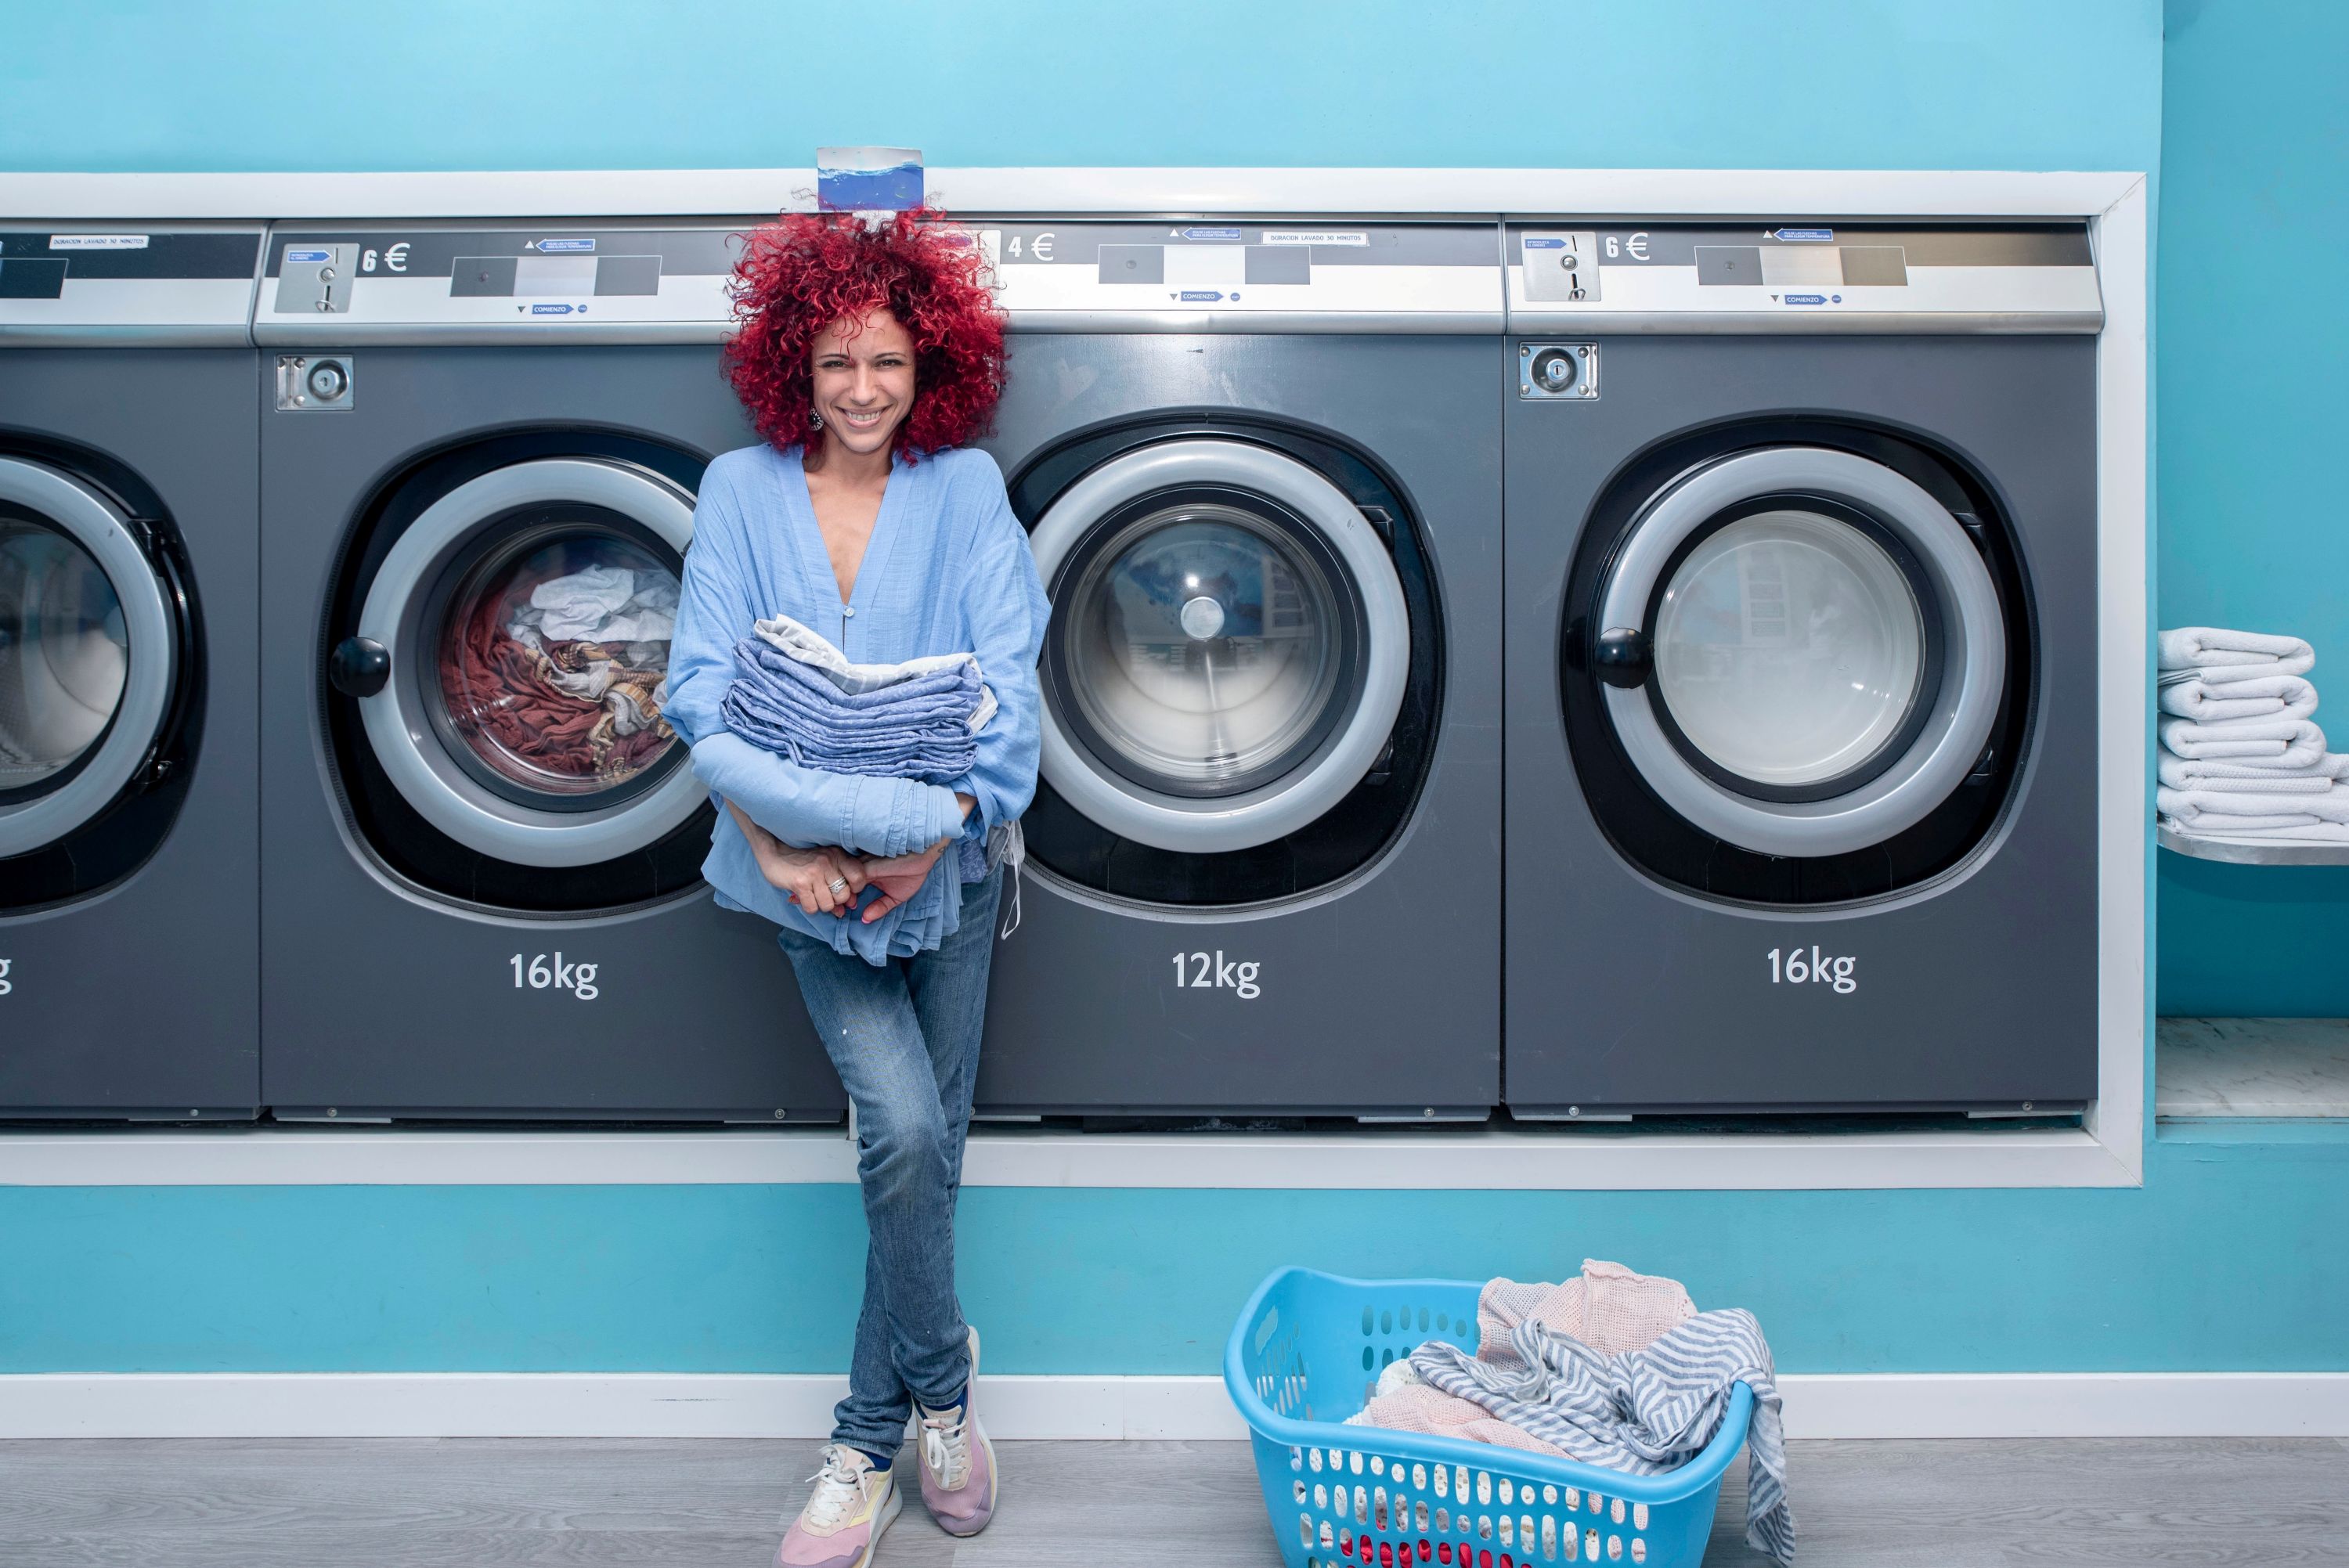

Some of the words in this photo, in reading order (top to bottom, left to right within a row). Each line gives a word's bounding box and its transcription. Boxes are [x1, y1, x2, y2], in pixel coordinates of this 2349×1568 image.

[363, 249, 378, 272] 6
[384, 243, 410, 272] €
[1008, 236, 1023, 258] 4
[1030, 232, 1055, 261] €
[1605, 236, 1619, 258] 6
[1625, 232, 1651, 261] €
[510, 951, 599, 1000] 16kg
[1172, 950, 1261, 999] 12kg
[1767, 945, 1856, 993] 16kg
